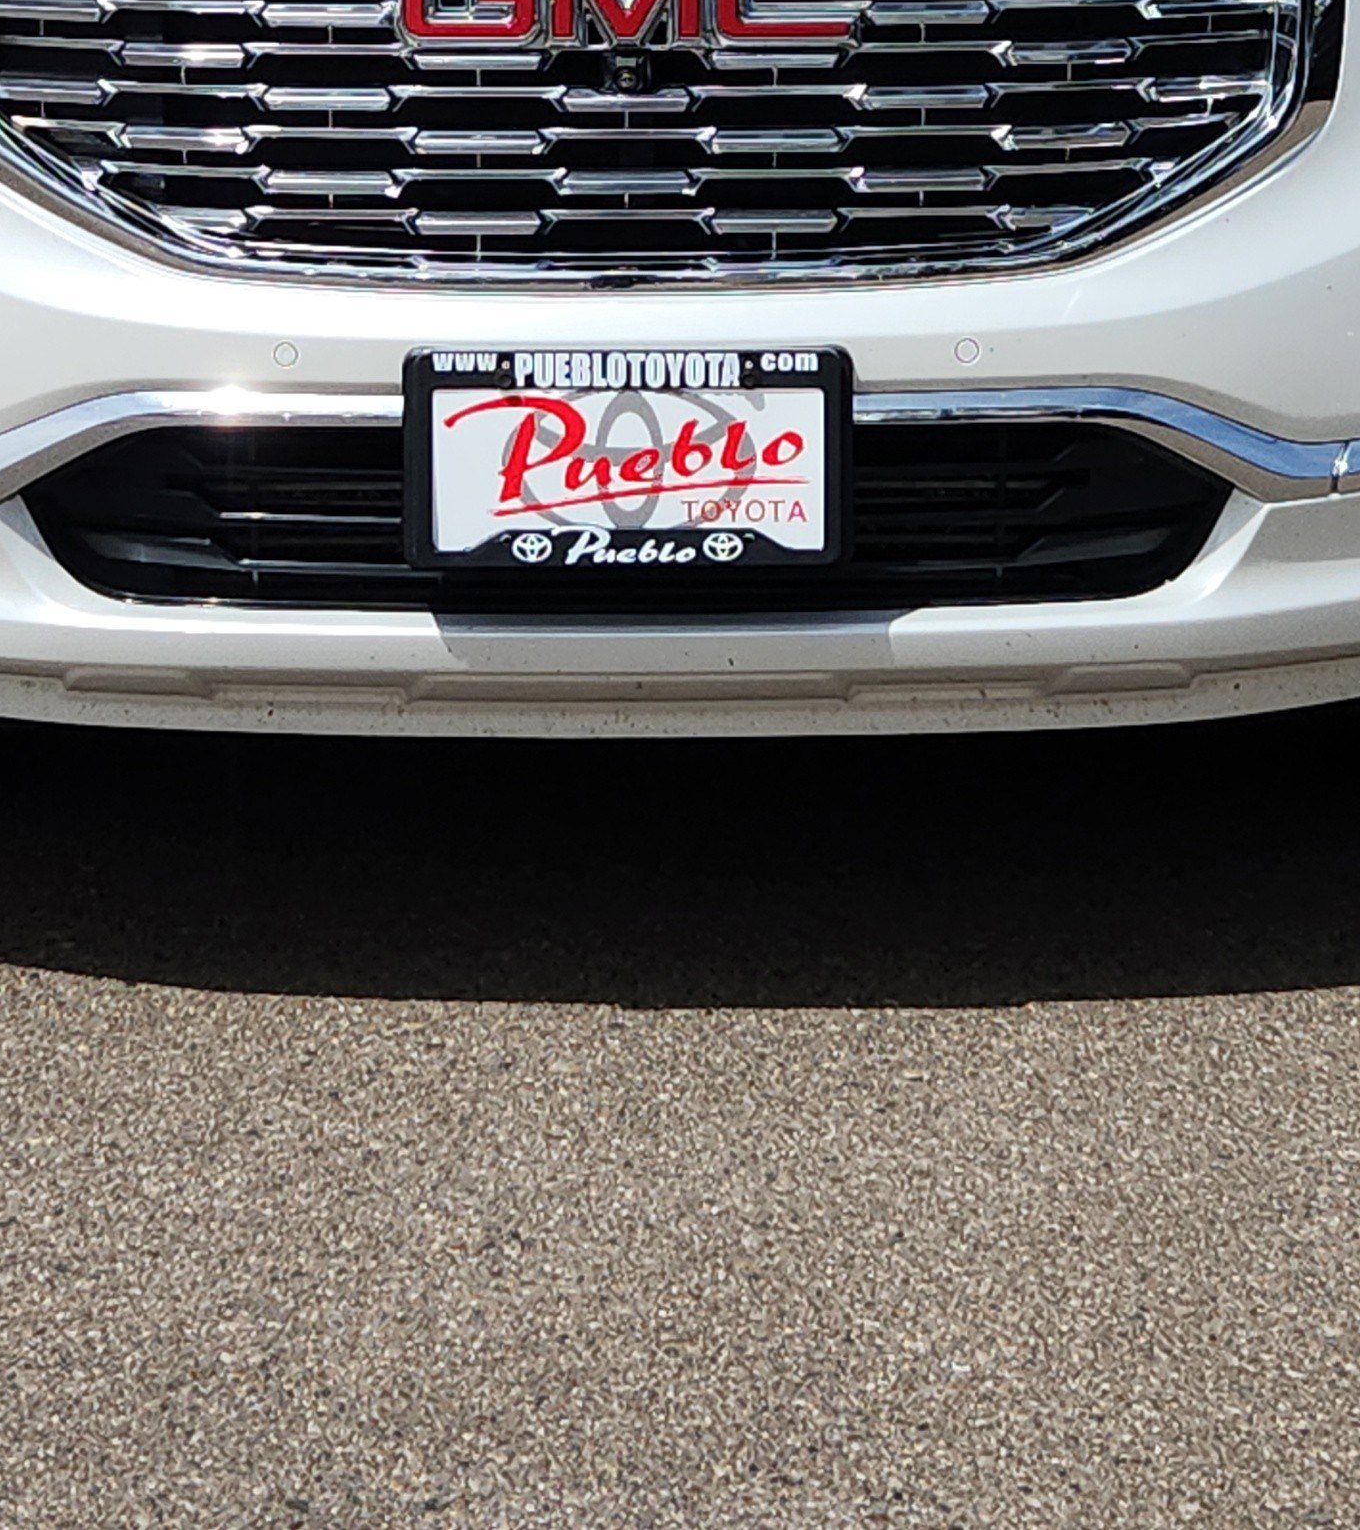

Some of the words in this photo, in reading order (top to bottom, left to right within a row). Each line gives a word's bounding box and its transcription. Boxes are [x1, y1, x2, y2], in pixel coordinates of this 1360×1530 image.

[442, 395, 806, 503] Pueblo
[680, 499, 808, 523] TOYOTA
[550, 524, 698, 566] Pueblo
